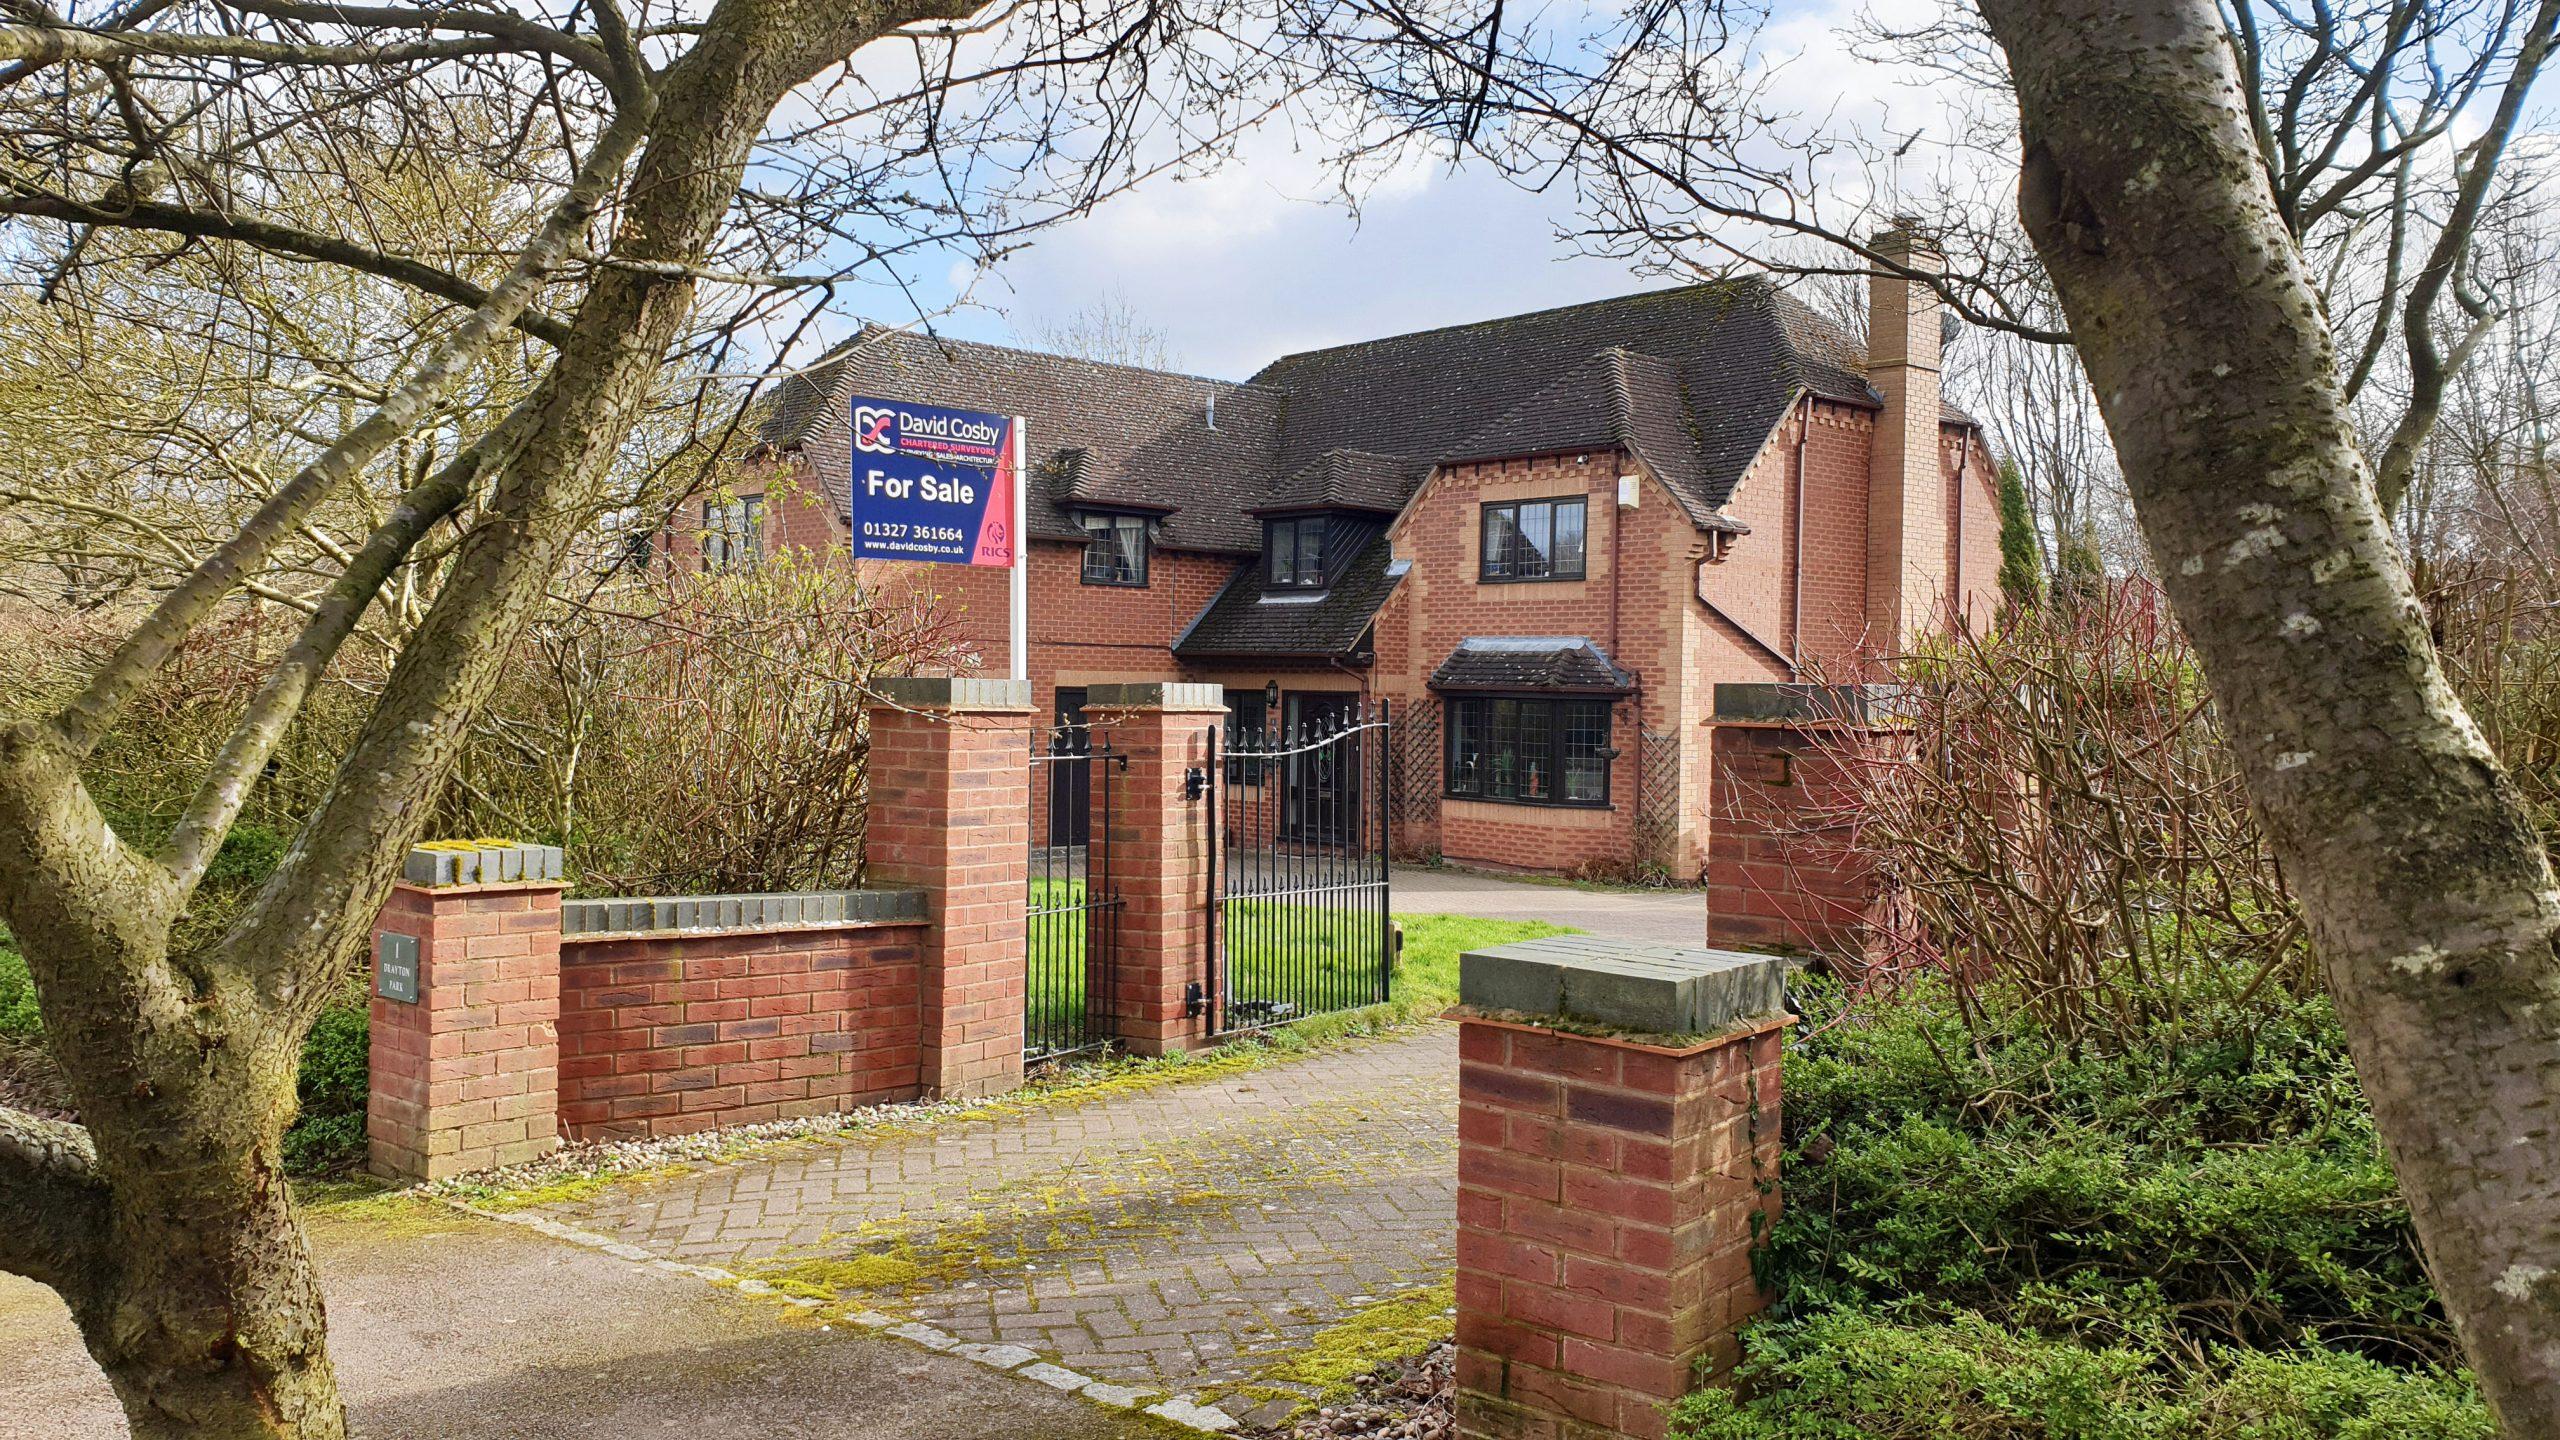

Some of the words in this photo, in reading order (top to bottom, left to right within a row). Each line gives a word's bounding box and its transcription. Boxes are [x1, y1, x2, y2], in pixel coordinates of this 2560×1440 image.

[900, 411, 947, 436] David
[951, 418, 1000, 446] Cosby
[900, 437, 948, 451] CHARTERED
[950, 444, 996, 456] SURVEYORS
[868, 470, 913, 498] For
[920, 475, 974, 504] Sale
[864, 521, 908, 537] 01327
[913, 526, 963, 541] 361664
[864, 540, 964, 555] www.davidcosby.co.uk
[981, 546, 1010, 558] RICS
[383, 962, 411, 977] DRAYTON
[388, 980, 404, 992] PARK
